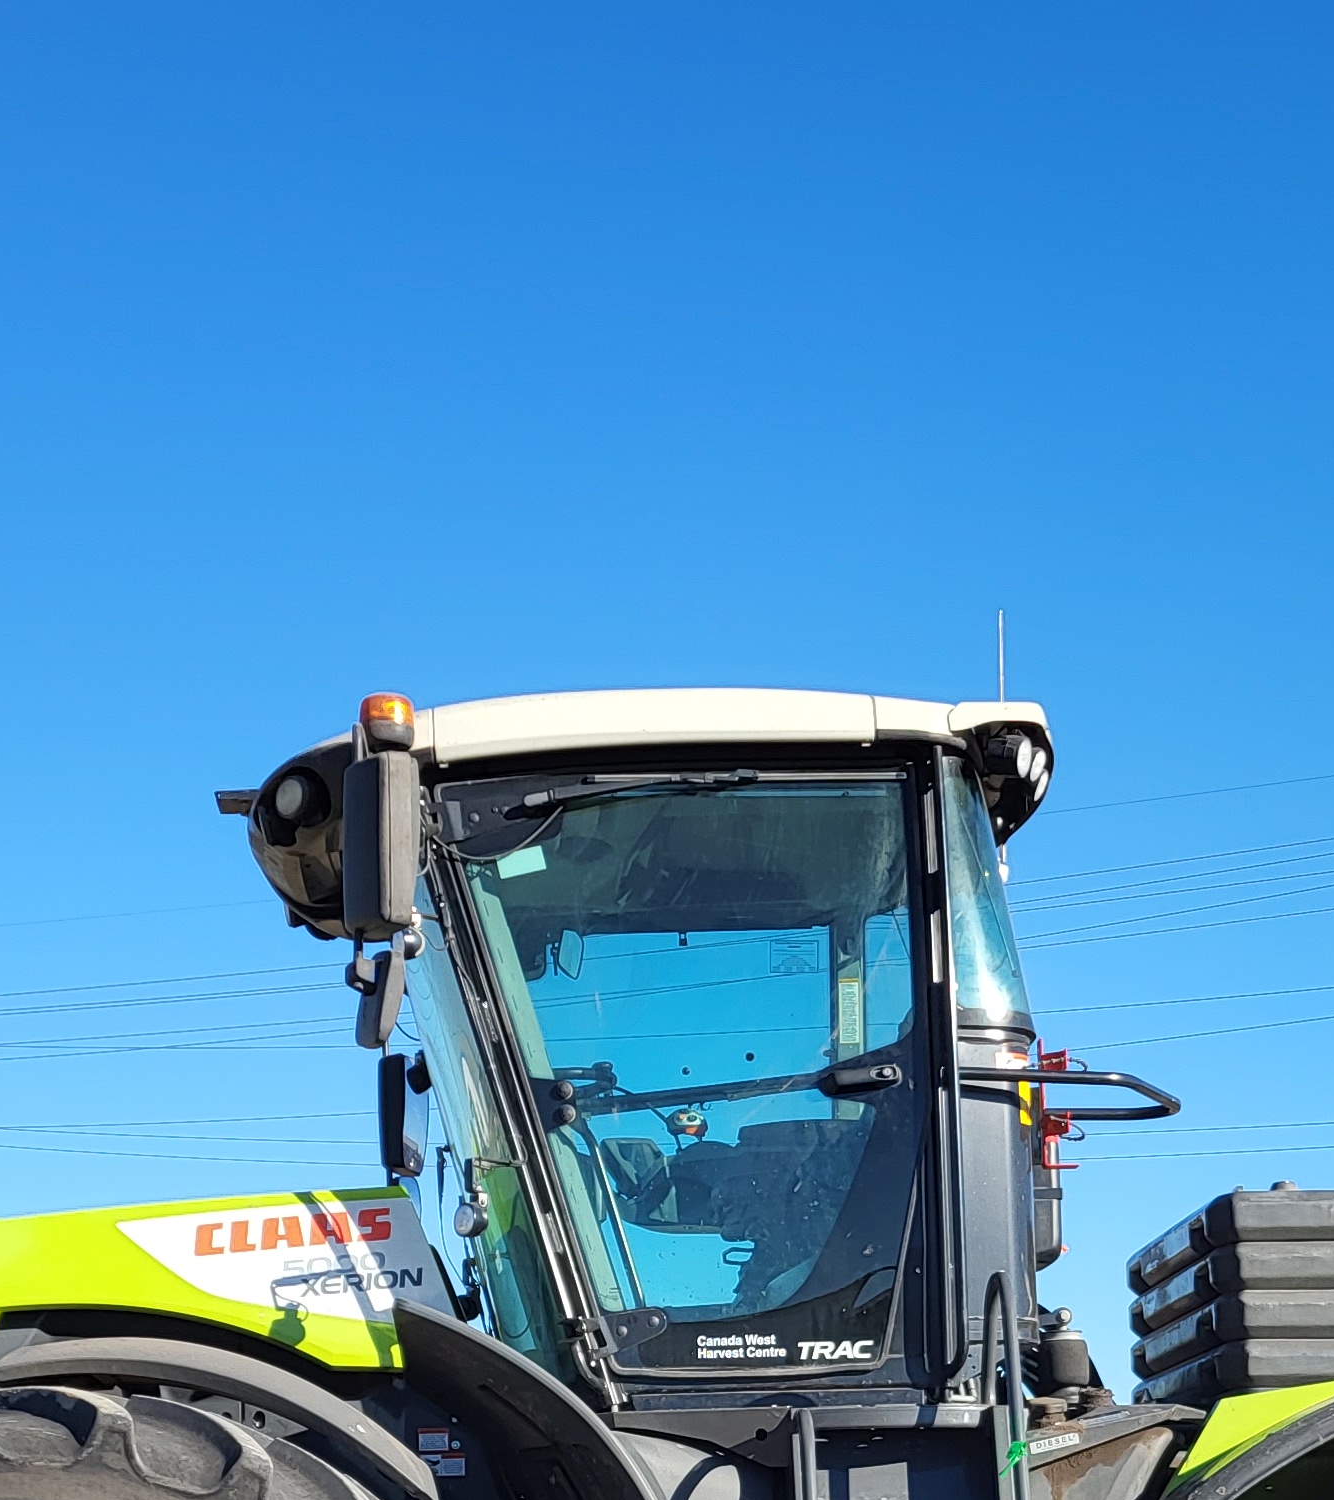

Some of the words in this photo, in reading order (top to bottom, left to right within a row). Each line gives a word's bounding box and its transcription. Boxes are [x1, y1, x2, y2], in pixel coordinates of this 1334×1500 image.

[194, 1207, 392, 1257] CLAAS
[283, 1251, 386, 1276] 5000
[300, 1266, 424, 1298] XERION
[697, 1335, 743, 1347] Canada
[745, 1334, 776, 1346] West
[797, 1340, 874, 1360] TRAC
[697, 1347, 744, 1359] Harvest
[746, 1346, 787, 1358] Centre
